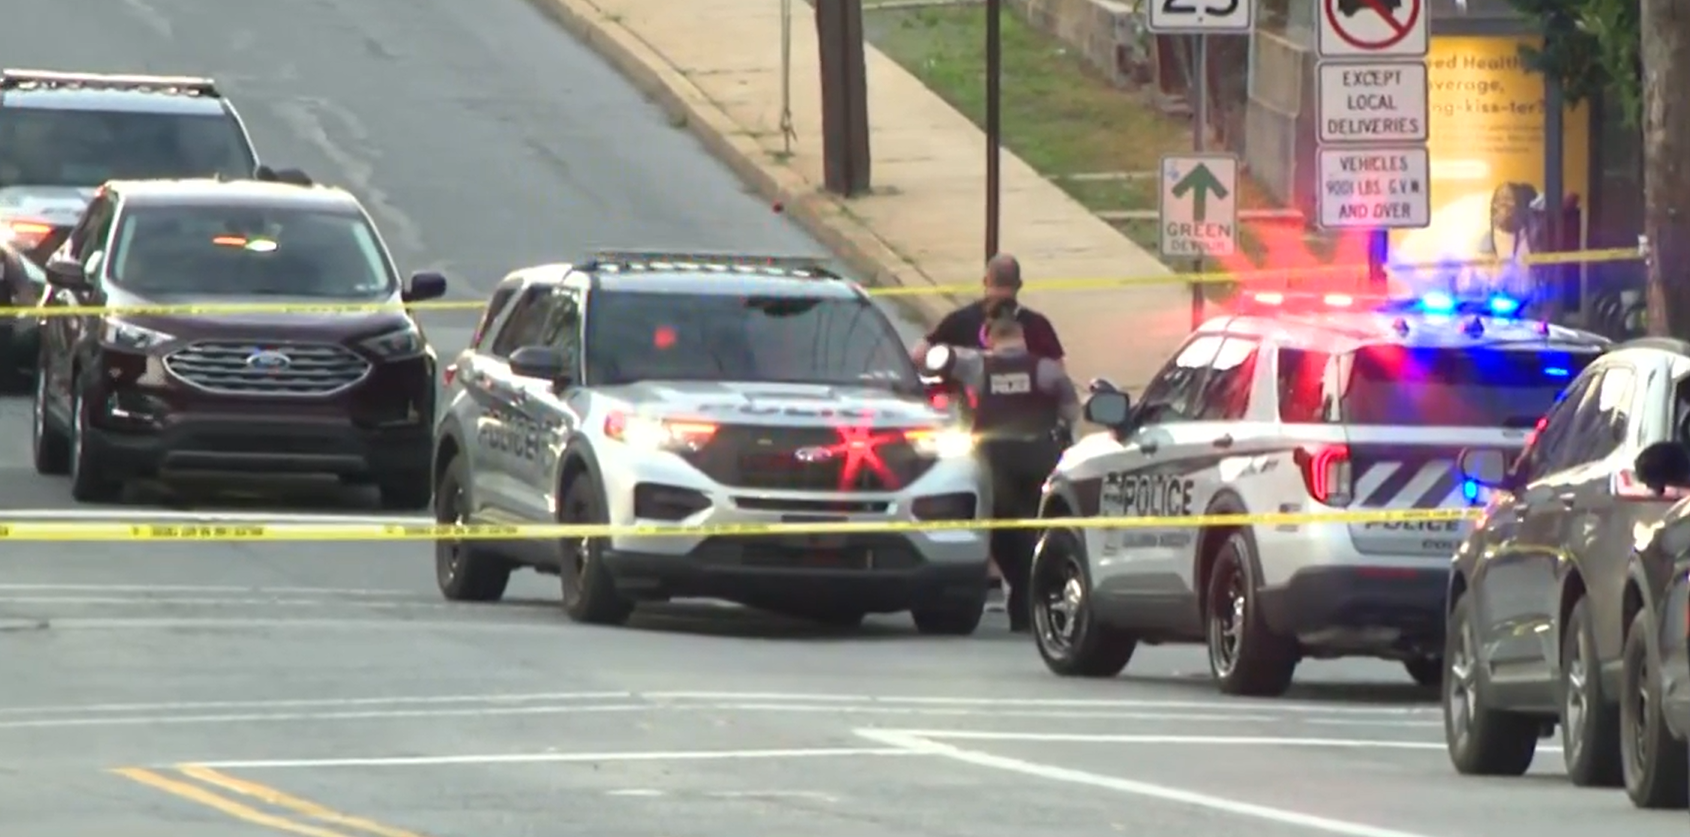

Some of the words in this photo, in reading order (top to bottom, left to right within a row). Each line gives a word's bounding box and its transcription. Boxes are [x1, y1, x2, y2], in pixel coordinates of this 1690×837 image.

[1343, 70, 1402, 87] EXCEPT
[1347, 94, 1397, 110] LOCAL
[1328, 118, 1419, 134] DELIVERIES
[1340, 156, 1408, 171] VEHICLES
[1339, 204, 1368, 218] AND
[1373, 203, 1411, 218] OVER
[1167, 222, 1231, 237] GREEN
[1122, 475, 1194, 517] POLICE
